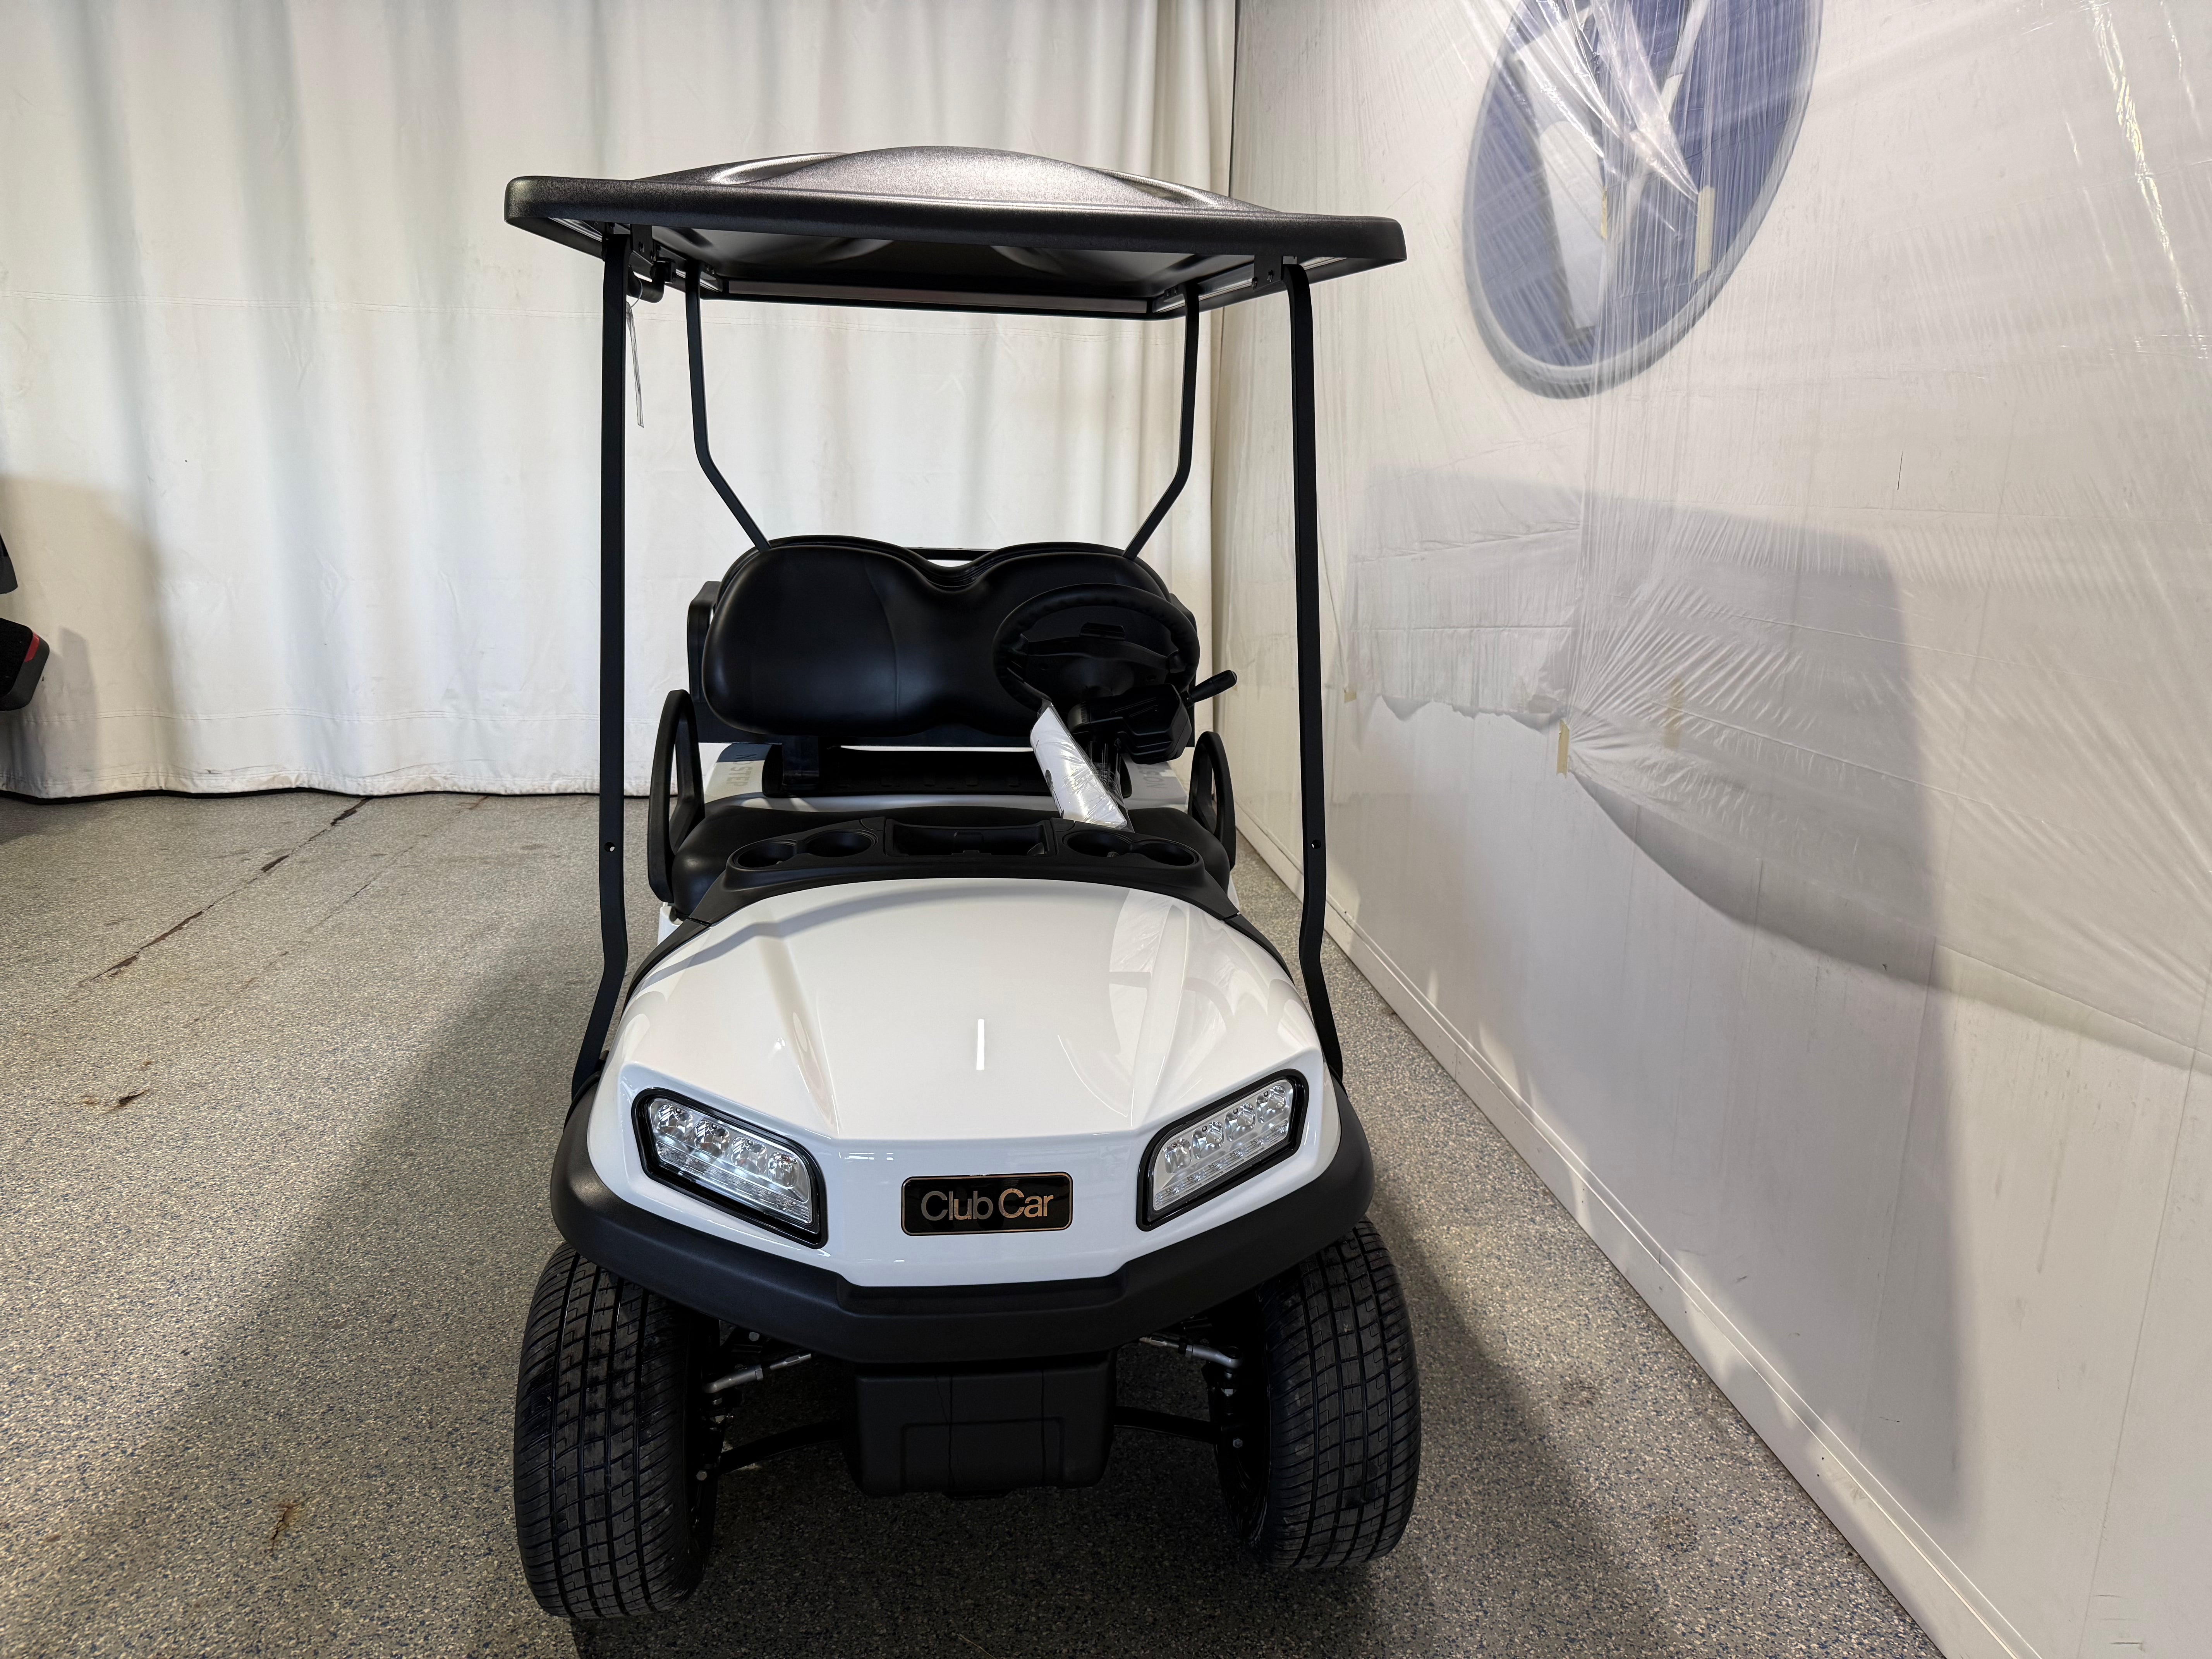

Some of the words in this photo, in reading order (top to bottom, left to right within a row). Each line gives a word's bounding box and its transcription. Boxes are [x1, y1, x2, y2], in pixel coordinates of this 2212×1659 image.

[733, 754, 757, 765] NO
[725, 766, 753, 786] STEP
[1143, 776, 1168, 788] NO
[921, 1190, 994, 1221] Club
[999, 1188, 1054, 1219] Car
